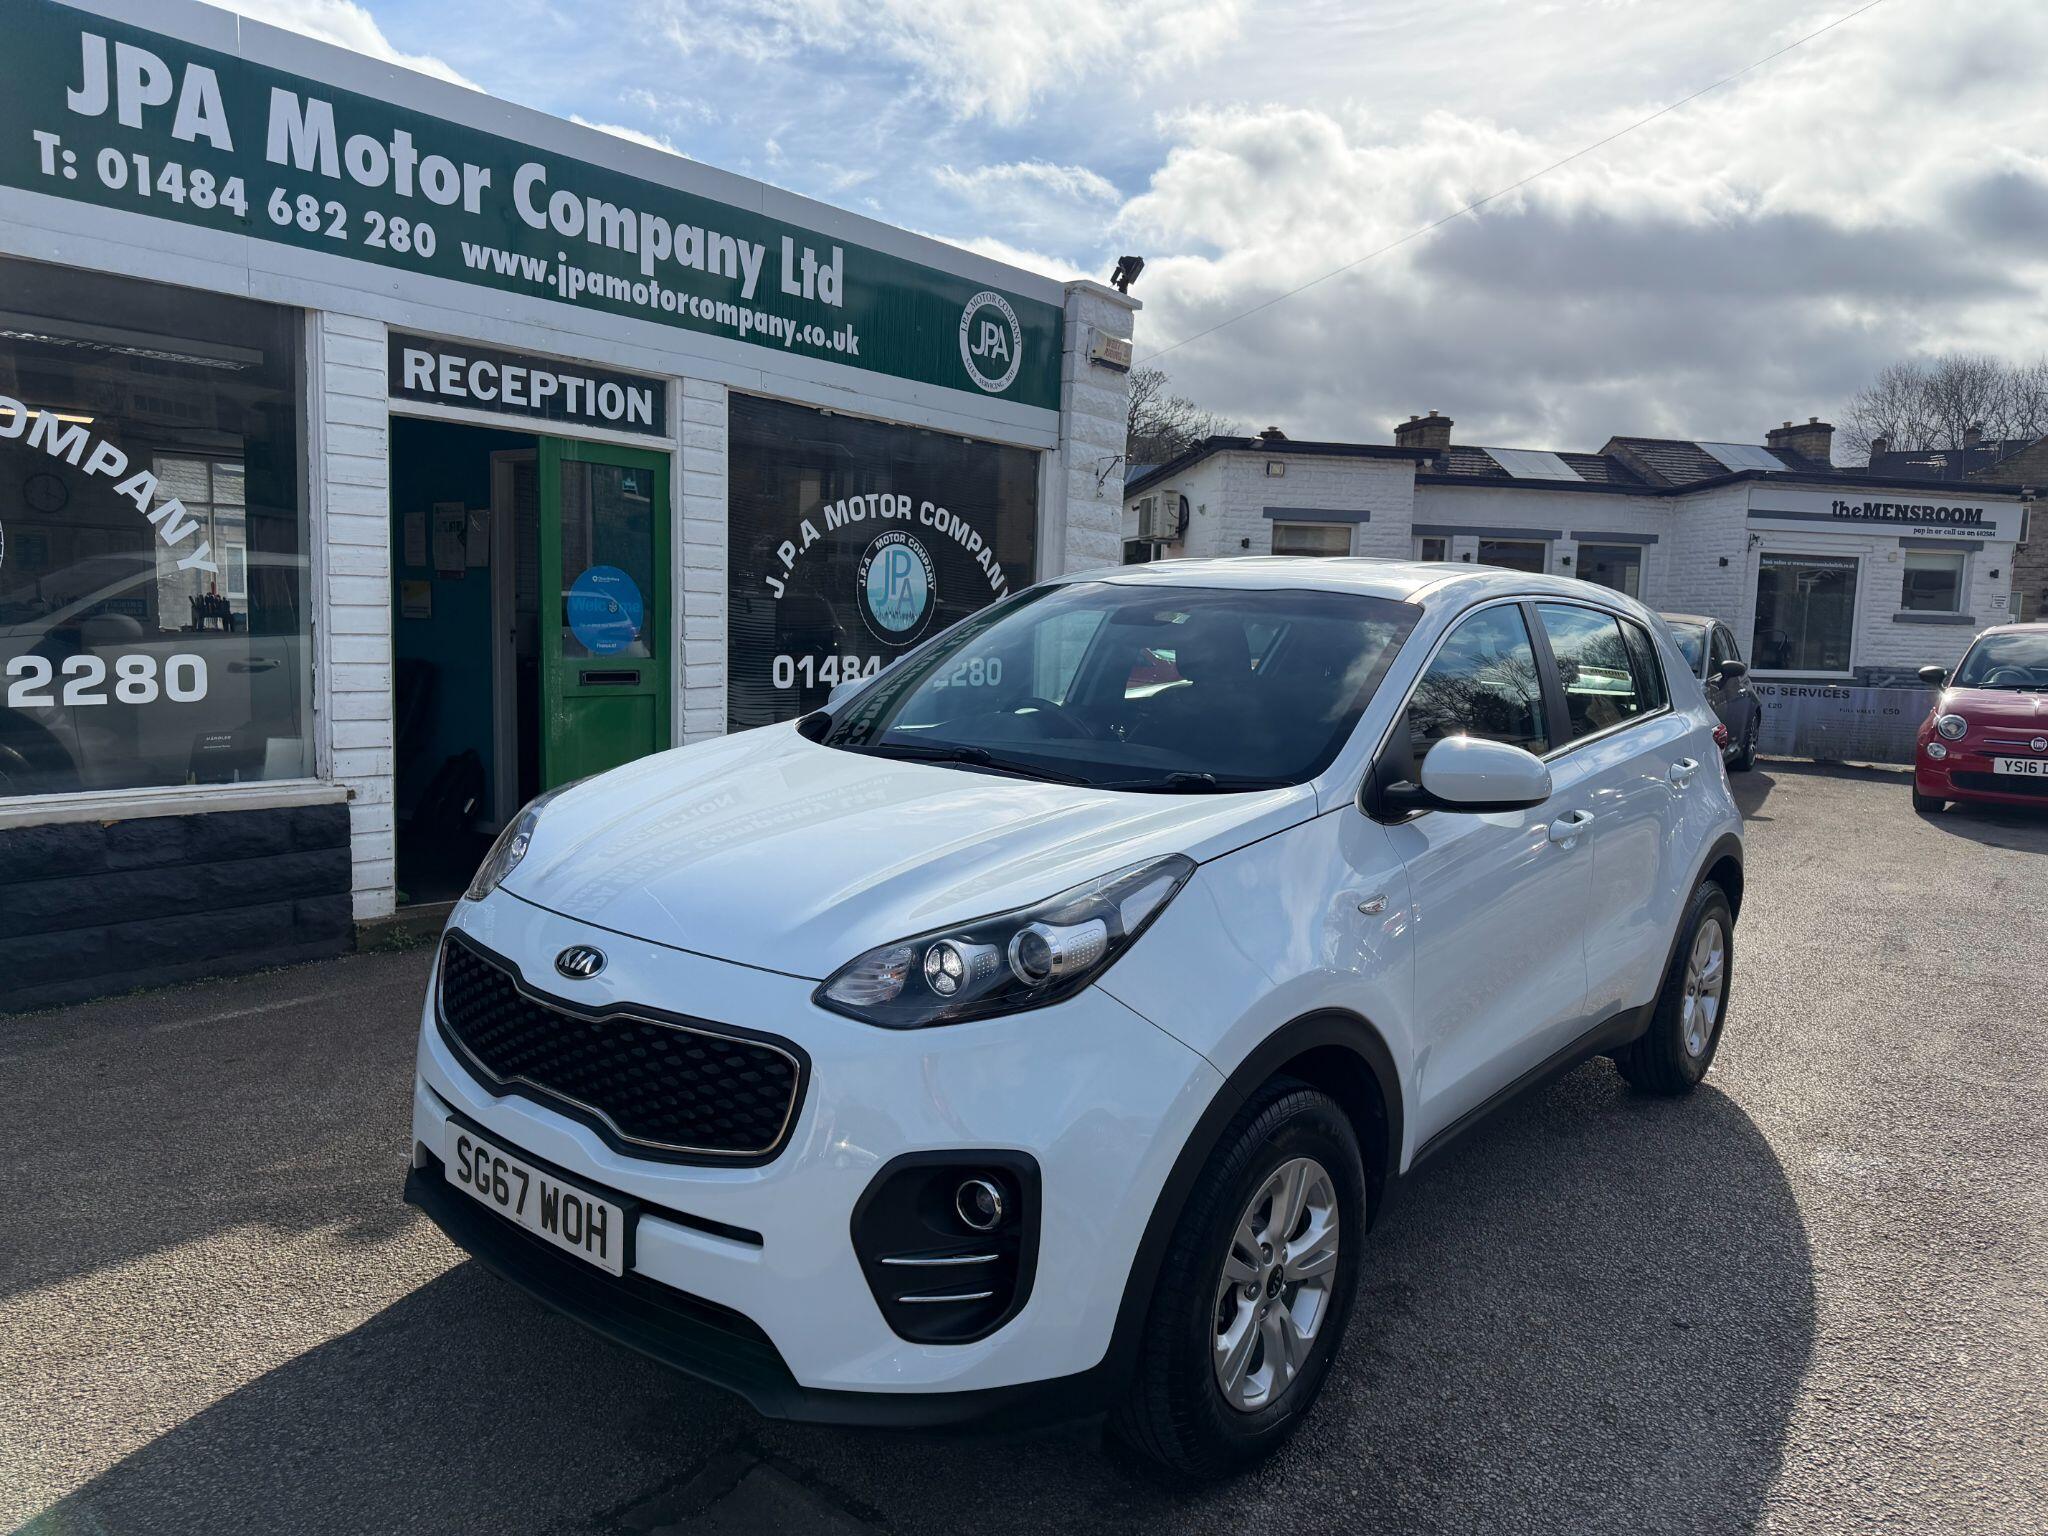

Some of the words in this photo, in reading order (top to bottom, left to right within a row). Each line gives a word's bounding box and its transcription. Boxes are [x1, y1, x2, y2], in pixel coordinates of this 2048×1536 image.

[67, 32, 233, 152] JPA
[266, 87, 491, 213] Motor
[513, 163, 765, 299] Company
[782, 236, 842, 307] Ltd
[34, 130, 77, 179] T:
[98, 148, 248, 216] 01484
[268, 188, 347, 239] 682
[364, 211, 436, 258] 280
[461, 242, 859, 355] www.jpamotorcompany.co.uk
[970, 293, 997, 309] MOTOR
[998, 299, 1021, 346] COMPANY
[971, 320, 1010, 362] JPA
[404, 349, 652, 424] RECEPTION
[765, 519, 821, 599] J.P.A
[823, 493, 912, 531] MOTOR
[874, 533, 906, 550] MOTOR
[908, 538, 935, 590] COMPANY
[7, 654, 208, 708] 2280
[1780, 686, 1850, 699] SERVICES
[2004, 760, 2038, 774] YS16
[559, 948, 597, 974] KIA
[457, 1135, 530, 1216] SG67
[540, 1180, 608, 1260] WOH
